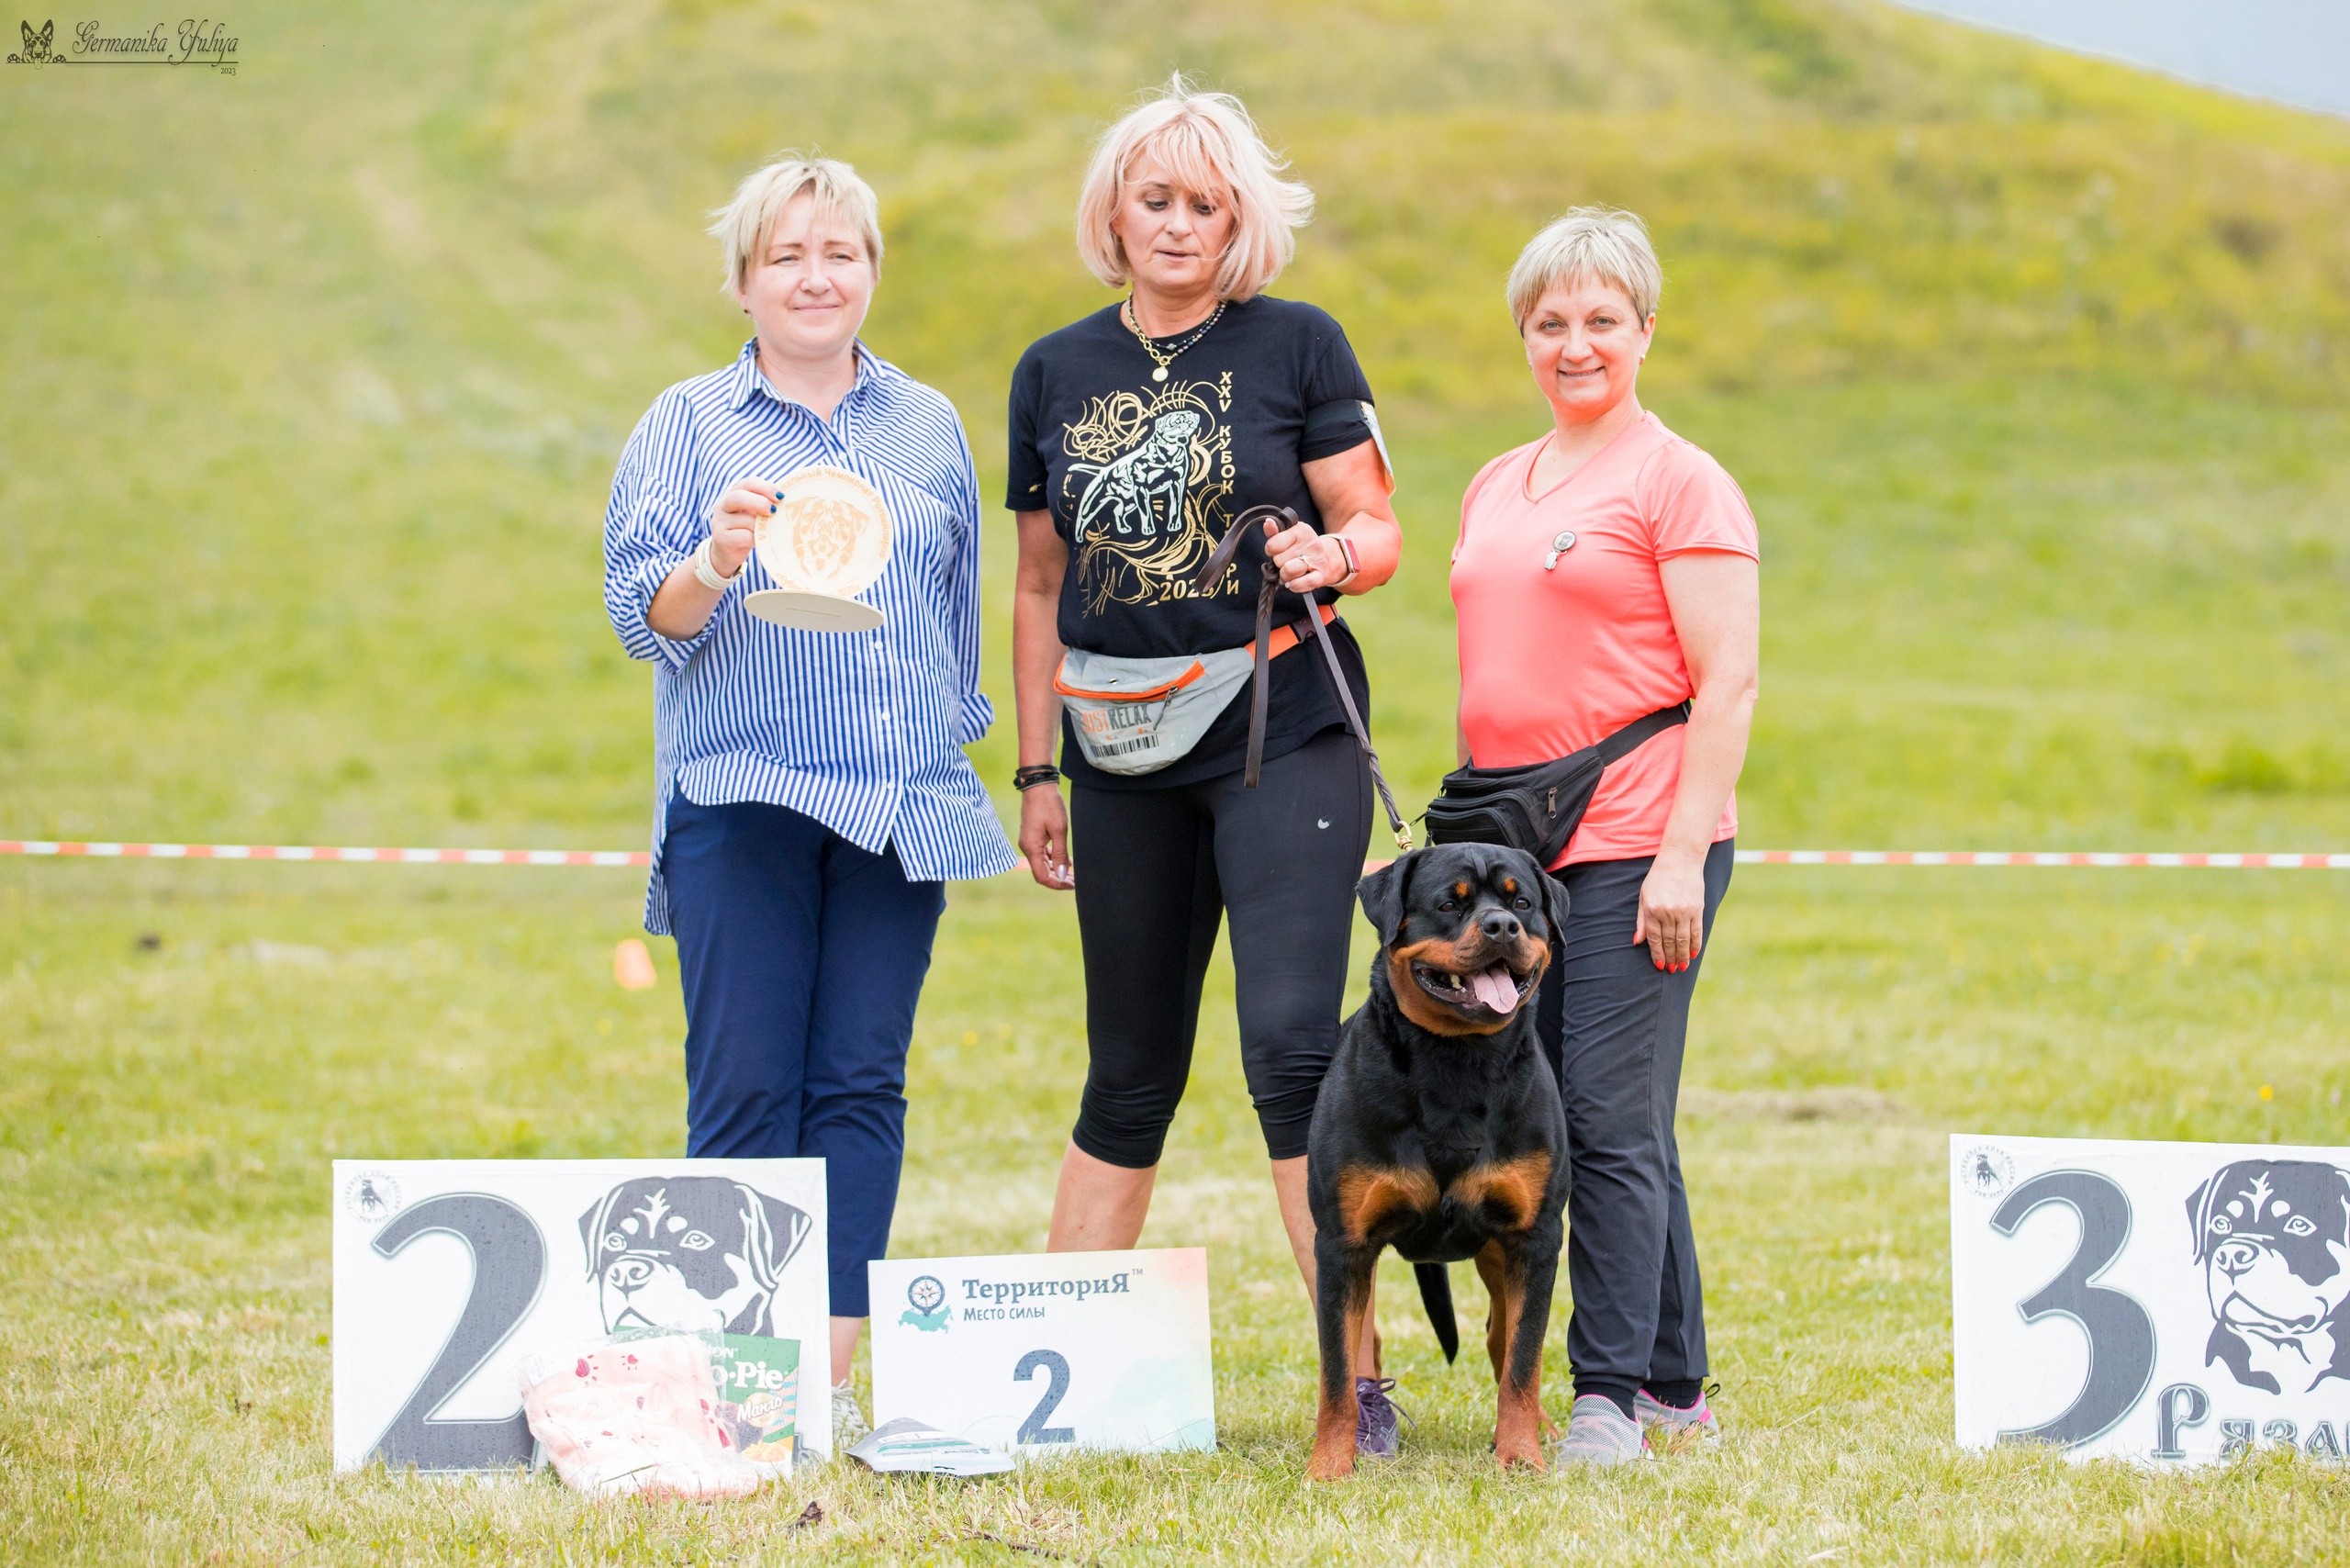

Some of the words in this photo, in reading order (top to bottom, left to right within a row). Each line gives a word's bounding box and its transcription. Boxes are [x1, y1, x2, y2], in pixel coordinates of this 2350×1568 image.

[1219, 371, 1233, 412] XXV
[1219, 425, 1236, 495] КУБОК
[824, 467, 873, 498] Чемпионат
[871, 496, 891, 560] Ротвейлеров
[962, 1272, 1130, 1305] ТерриториЯ
[1988, 1169, 2156, 1451] 3
[367, 1192, 547, 1473] 2
[737, 1395, 784, 1423] Манго
[1013, 1349, 1076, 1446] 2
